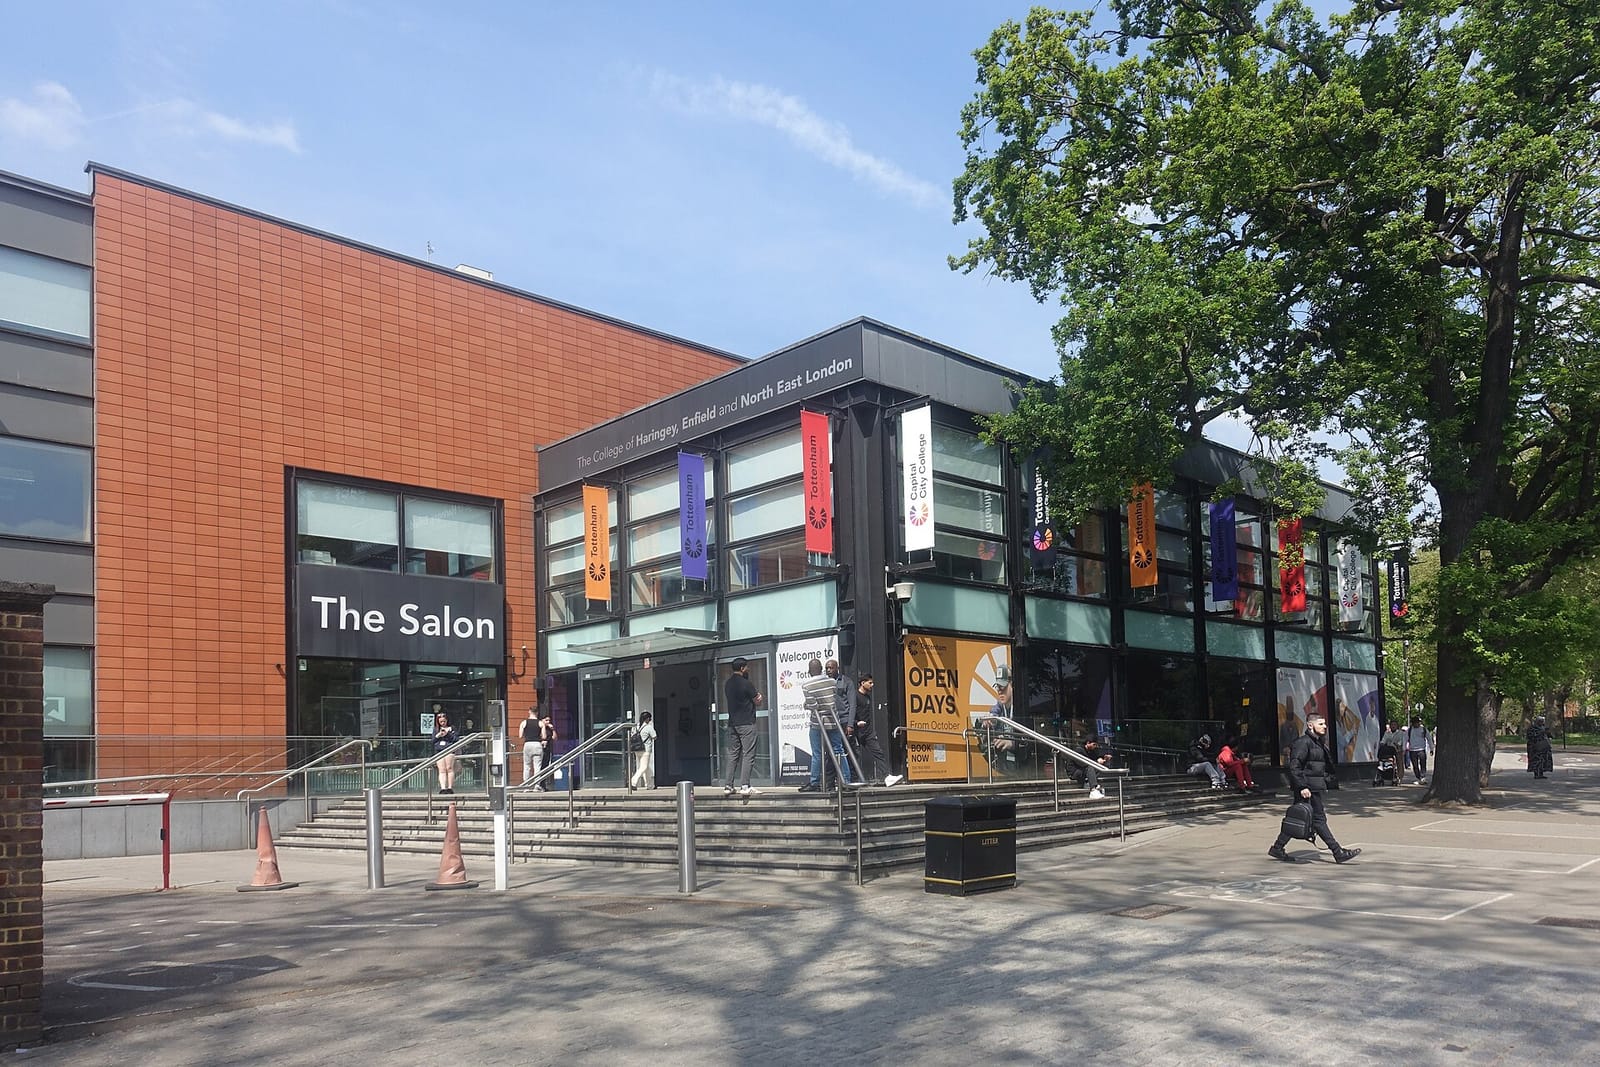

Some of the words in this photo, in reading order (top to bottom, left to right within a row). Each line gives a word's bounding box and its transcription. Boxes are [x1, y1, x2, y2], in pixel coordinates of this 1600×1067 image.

[577, 455, 592, 469] The
[593, 444, 624, 463] College
[625, 436, 634, 450] of
[636, 423, 679, 447] Haringey,
[682, 405, 716, 429] Enfield
[719, 397, 738, 416] and
[740, 384, 774, 409] North
[777, 375, 802, 395] East
[806, 358, 853, 384] London
[809, 435, 818, 499] Tottenham
[919, 433, 927, 474] College
[909, 463, 918, 501] Capital
[919, 477, 928, 498] City
[686, 474, 694, 532] Tottenham
[590, 505, 598, 558] Tottenham
[1393, 562, 1401, 600] Tottenham
[311, 595, 386, 633] The
[399, 603, 495, 640] Salon
[779, 650, 822, 663] Welcome
[824, 647, 834, 658] to
[909, 667, 959, 688] OPEN
[910, 693, 956, 714] DAYS
[910, 720, 930, 729] From
[931, 720, 960, 730] October
[911, 744, 932, 752] BOOK
[911, 754, 930, 763] NOW
